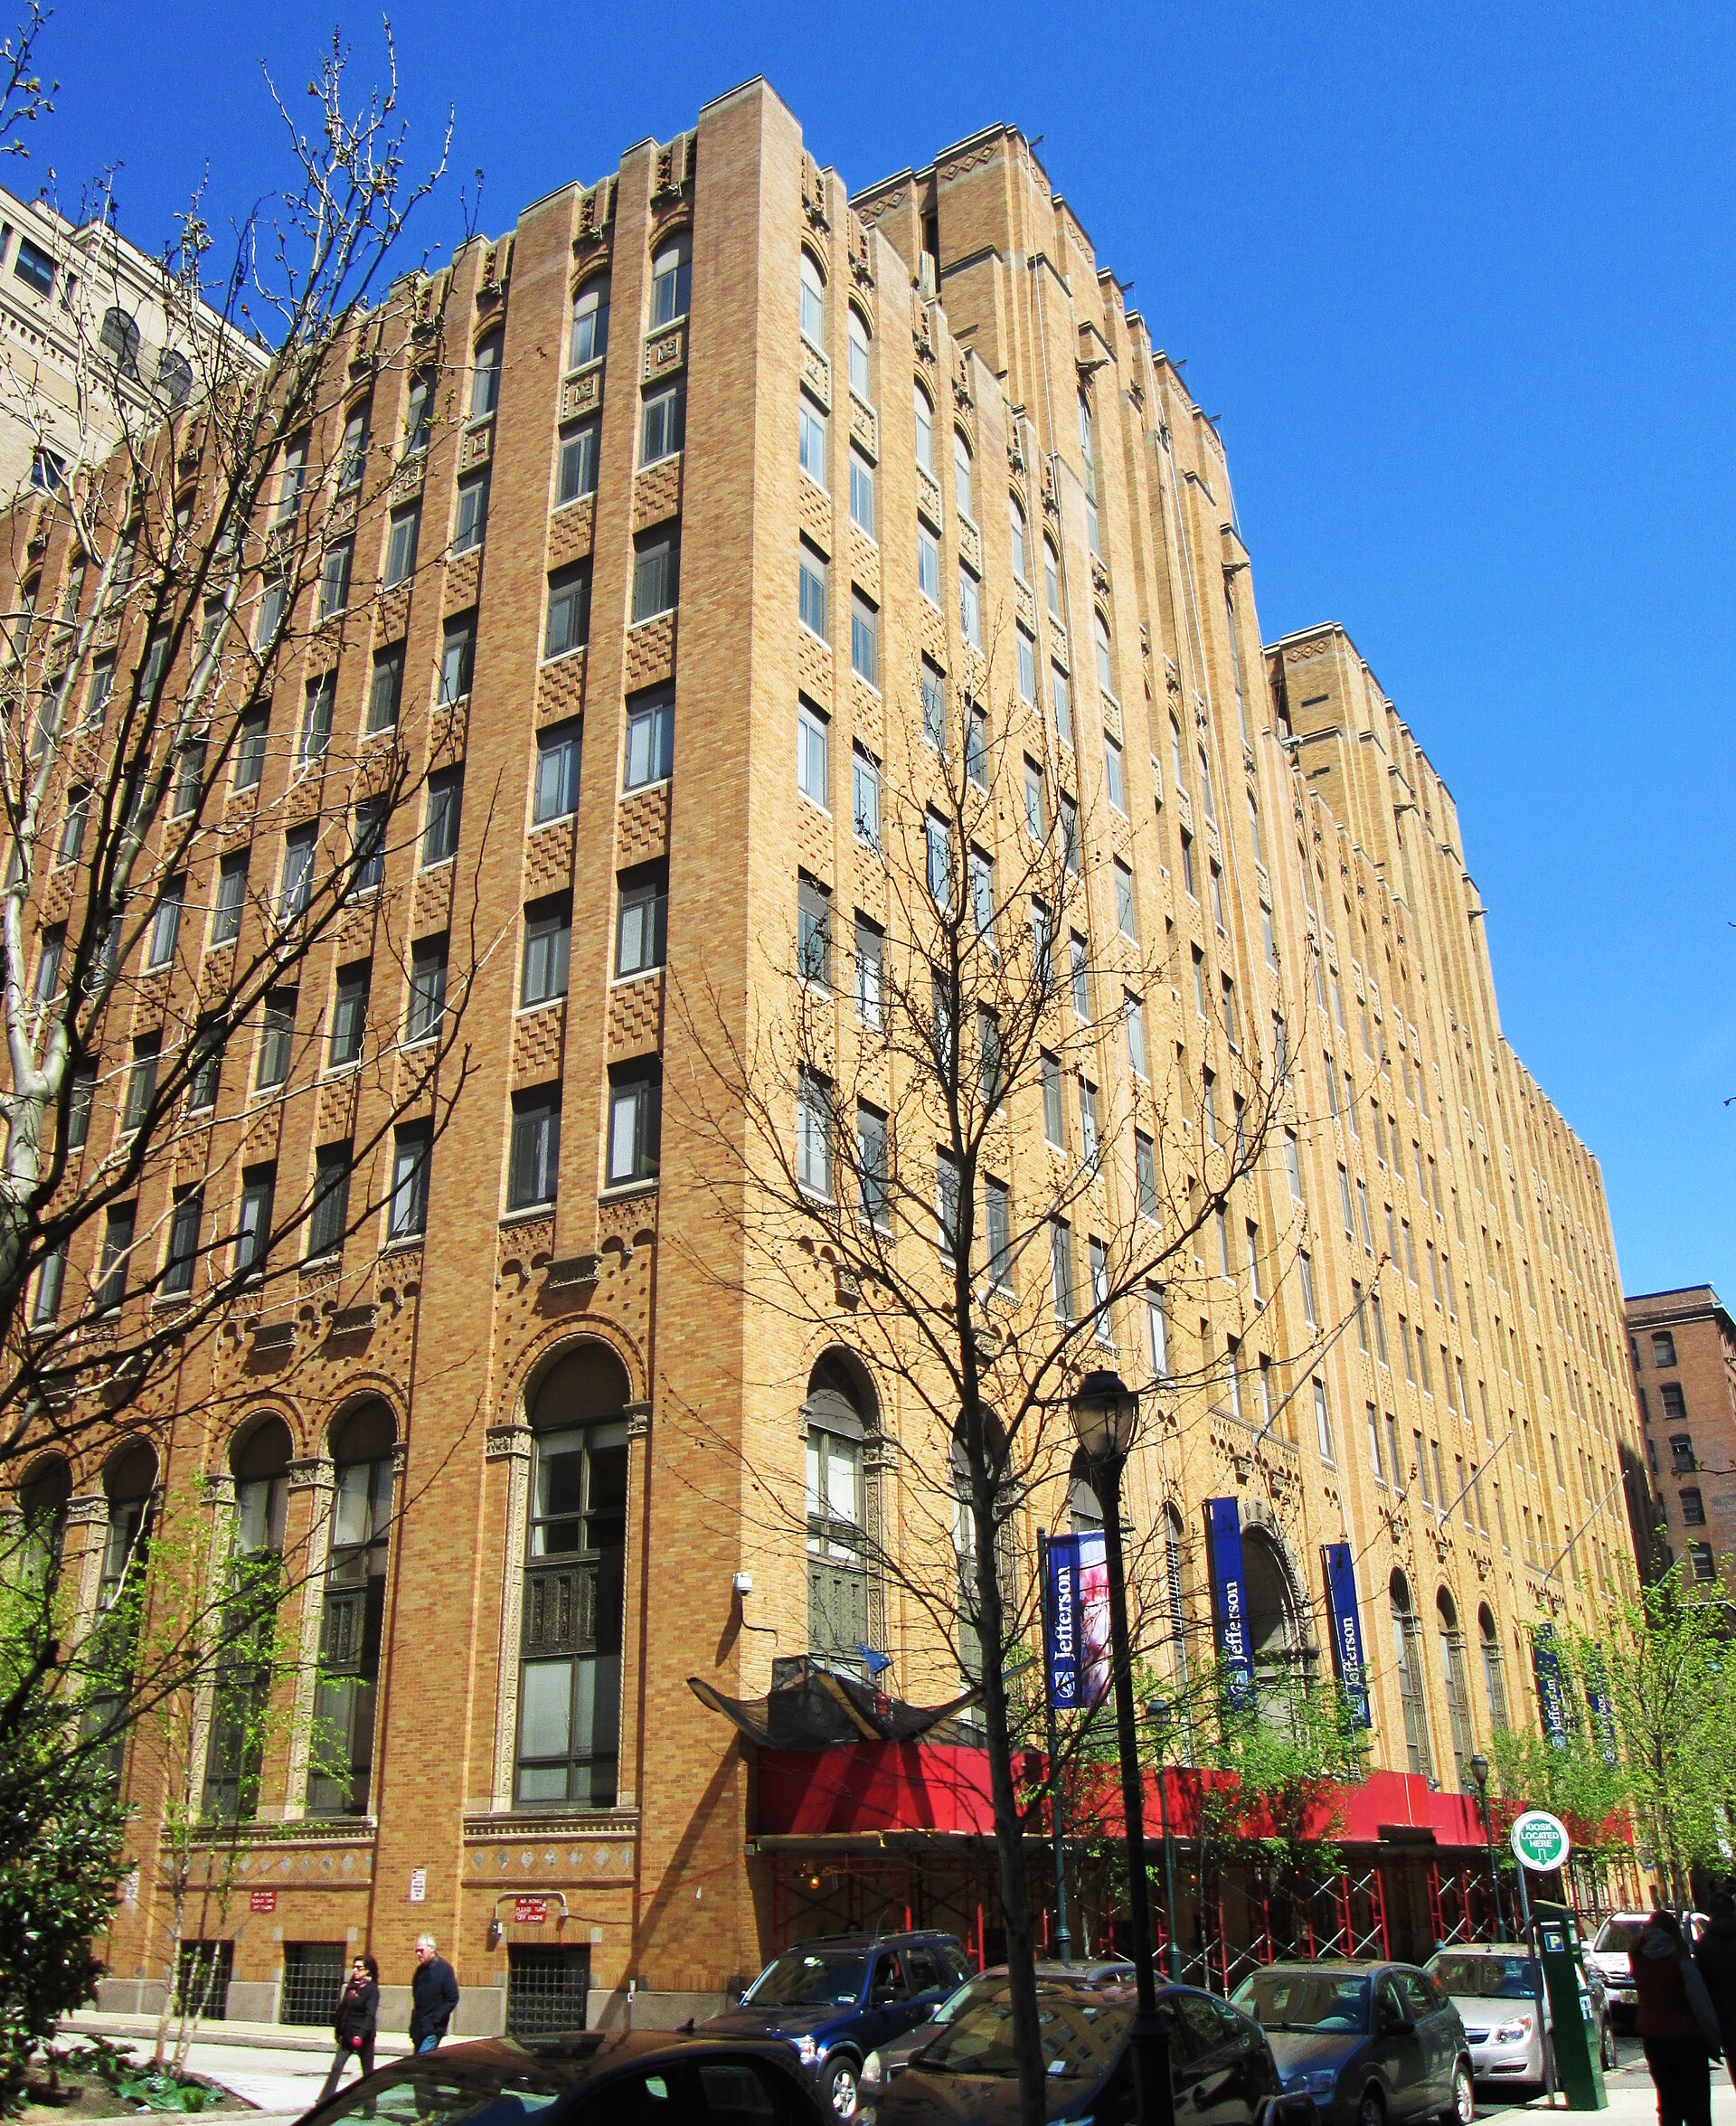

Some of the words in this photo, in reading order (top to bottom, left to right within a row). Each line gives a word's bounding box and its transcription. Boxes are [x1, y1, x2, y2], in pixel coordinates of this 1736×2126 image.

[1054, 1566, 1076, 1661] Jefferson
[1224, 1581, 1248, 1663] Jefferson
[1343, 1616, 1363, 1687] Jefferson
[1525, 1822, 1552, 1831] KIOSK
[1520, 1831, 1560, 1840] LOCATED
[1529, 1839, 1553, 1847] HERE
[1549, 1934, 1561, 1949] P
